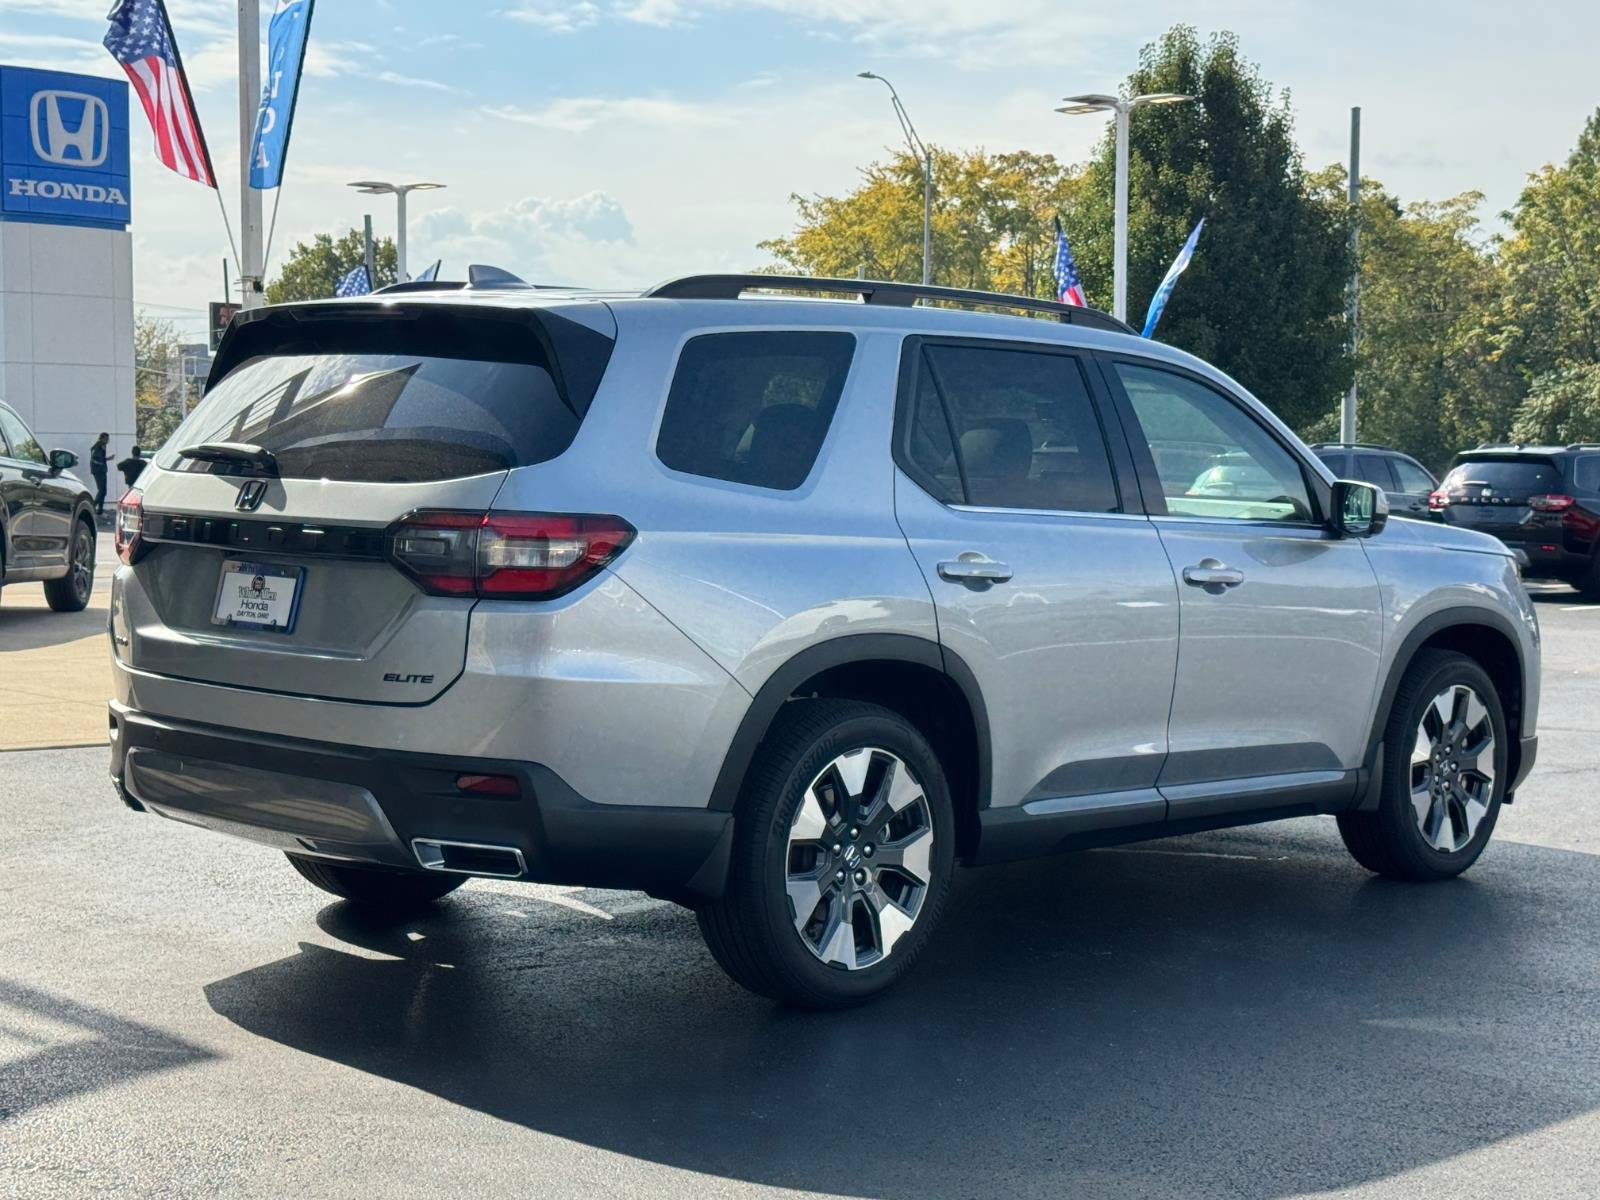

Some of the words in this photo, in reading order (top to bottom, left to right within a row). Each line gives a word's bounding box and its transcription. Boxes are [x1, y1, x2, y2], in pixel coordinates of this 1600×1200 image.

[8, 178, 128, 205] HONDA
[241, 600, 269, 611] Honda
[383, 673, 434, 684] ELITE
[773, 732, 840, 839] BRIDGESTONE
